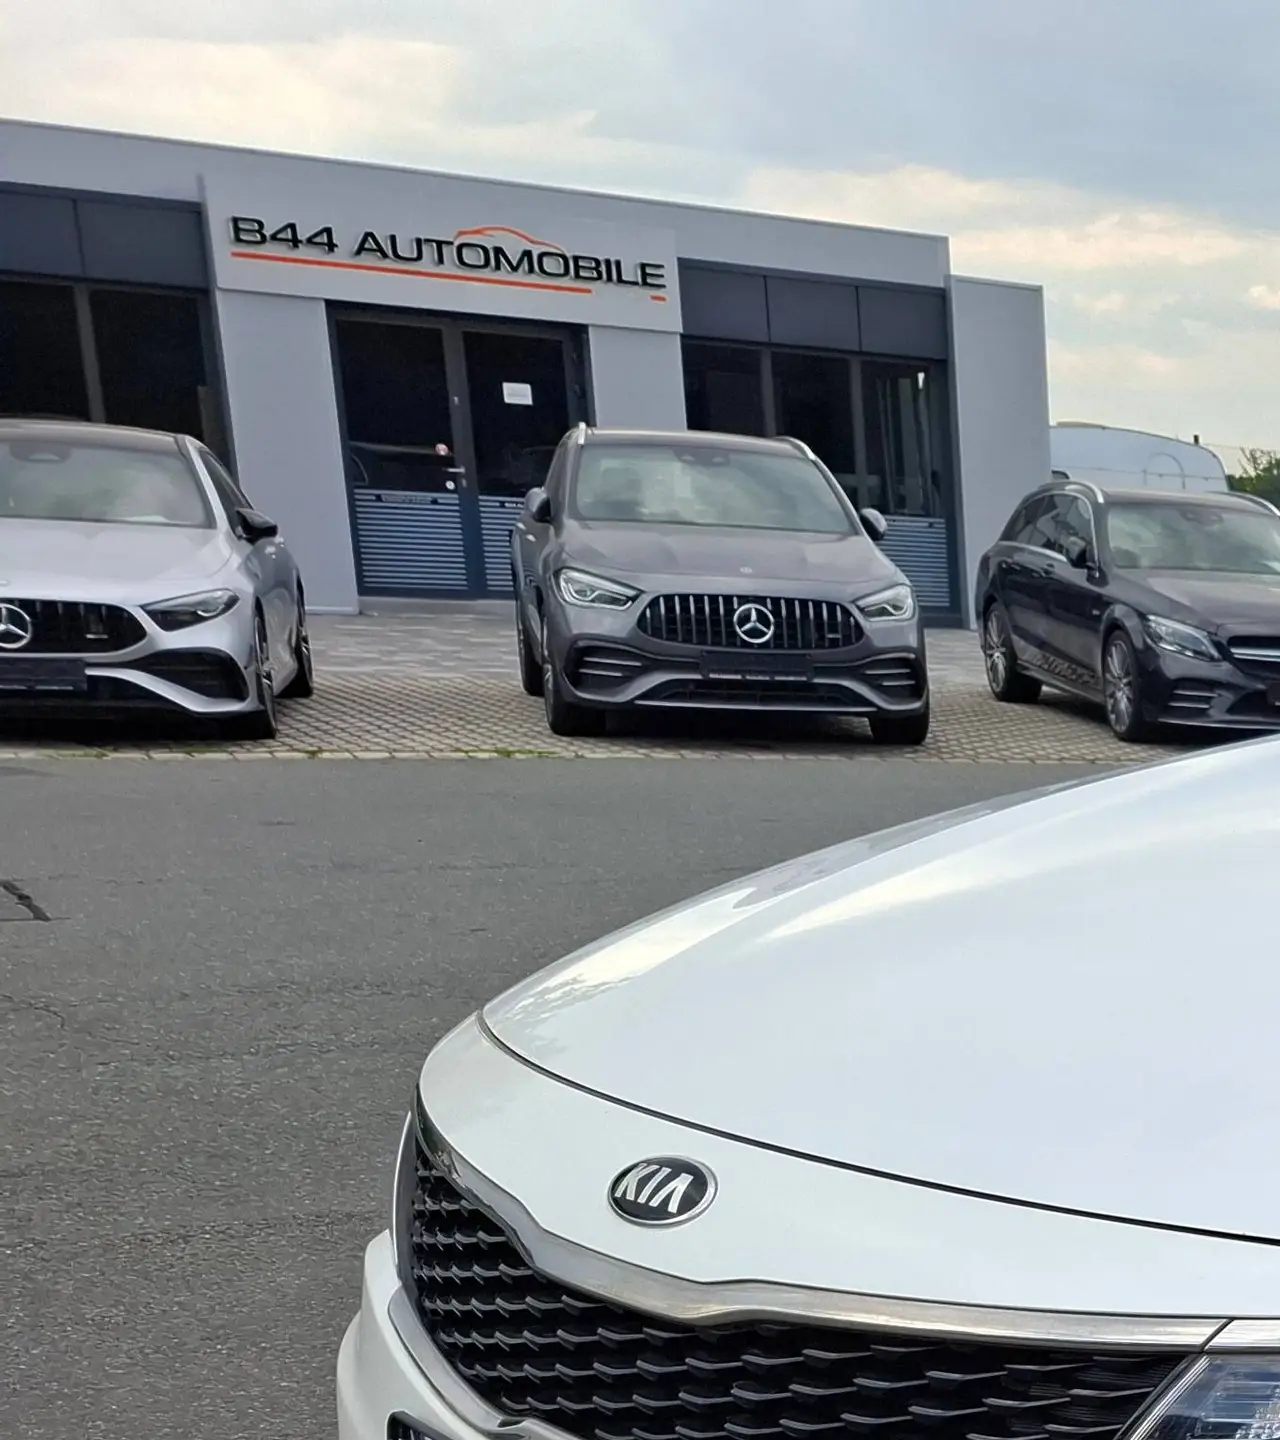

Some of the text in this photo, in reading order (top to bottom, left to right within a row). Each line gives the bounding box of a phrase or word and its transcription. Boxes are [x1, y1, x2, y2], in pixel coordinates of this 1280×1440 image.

[231, 215, 667, 290] B44 AUTOMOBILE
[614, 1162, 694, 1214] KIA
